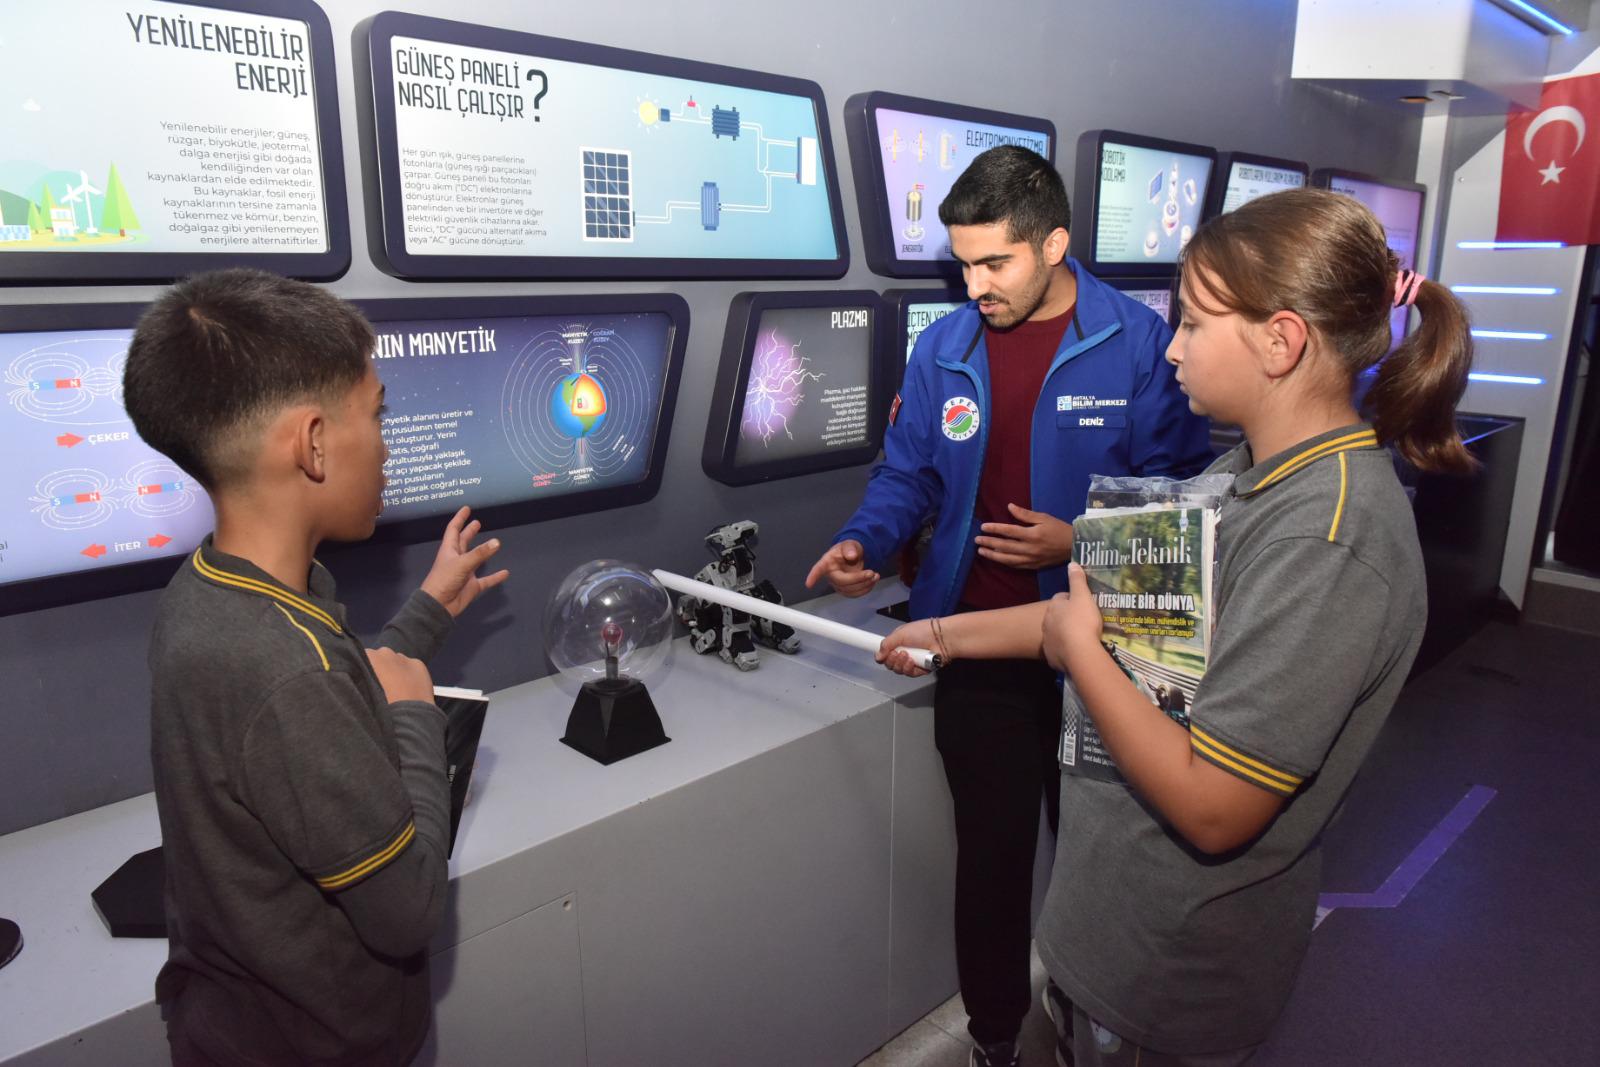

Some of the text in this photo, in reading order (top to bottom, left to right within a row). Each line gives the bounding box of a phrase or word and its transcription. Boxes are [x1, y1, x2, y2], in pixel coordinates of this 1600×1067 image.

[126, 12, 304, 62] YENİLENEBİLİR
[396, 46, 520, 88] GÜNEŞ PANELİ
[235, 62, 308, 98] ENERJİ
[398, 81, 524, 122] NASIL ÇALIŞIR
[526, 69, 548, 122] ?
[160, 120, 228, 134] Yenilenebilir
[180, 148, 312, 165] dalga enerjisi gibi doğada
[200, 162, 272, 174] kendiliğinden
[292, 168, 313, 176] olan
[148, 172, 222, 185] kaynaklardan
[224, 176, 247, 185] elde
[462, 174, 486, 183] paneli
[404, 182, 430, 190] doğru
[194, 187, 209, 196] Bu
[266, 189, 286, 198] fosil
[288, 190, 316, 200] enerji
[456, 195, 498, 204] Elektronlar
[164, 198, 317, 210] kaynaklarının tersine zamanla
[406, 204, 454, 212] panelinden
[524, 208, 544, 216] diğer
[173, 211, 228, 220] tükenmez
[408, 214, 442, 222] elektrikli
[168, 223, 319, 235] doğalgaz gibi yenilenemeyen
[490, 228, 524, 236] alternatif
[200, 236, 250, 246] enerjilere
[409, 236, 428, 244] veya
[832, 310, 868, 328] PLAZMA
[408, 326, 496, 356] MANYETİK
[412, 412, 440, 422] alanını
[442, 410, 462, 418] üretir
[1079, 416, 1104, 426] DENİZ
[392, 424, 432, 436] pusulanın
[434, 420, 458, 430] temel
[88, 432, 129, 446] ÇEKER
[436, 430, 456, 440] Yerin
[434, 450, 466, 460] yaklaşık
[396, 468, 408, 477] açı
[409, 464, 442, 474] yapacak
[444, 458, 472, 470] şekilde
[404, 472, 444, 485] pusulanın
[404, 484, 428, 494] olarak
[460, 476, 482, 486] kuzey
[401, 494, 430, 504] derece
[430, 488, 464, 500] arasında
[114, 541, 140, 553] İTER
[1080, 541, 1119, 566] Bilim
[1128, 536, 1192, 565] Teknik
[1098, 592, 1136, 608] ÖTESİNDE
[1138, 593, 1155, 610] BİR
[1157, 592, 1195, 611] DÜNYA
